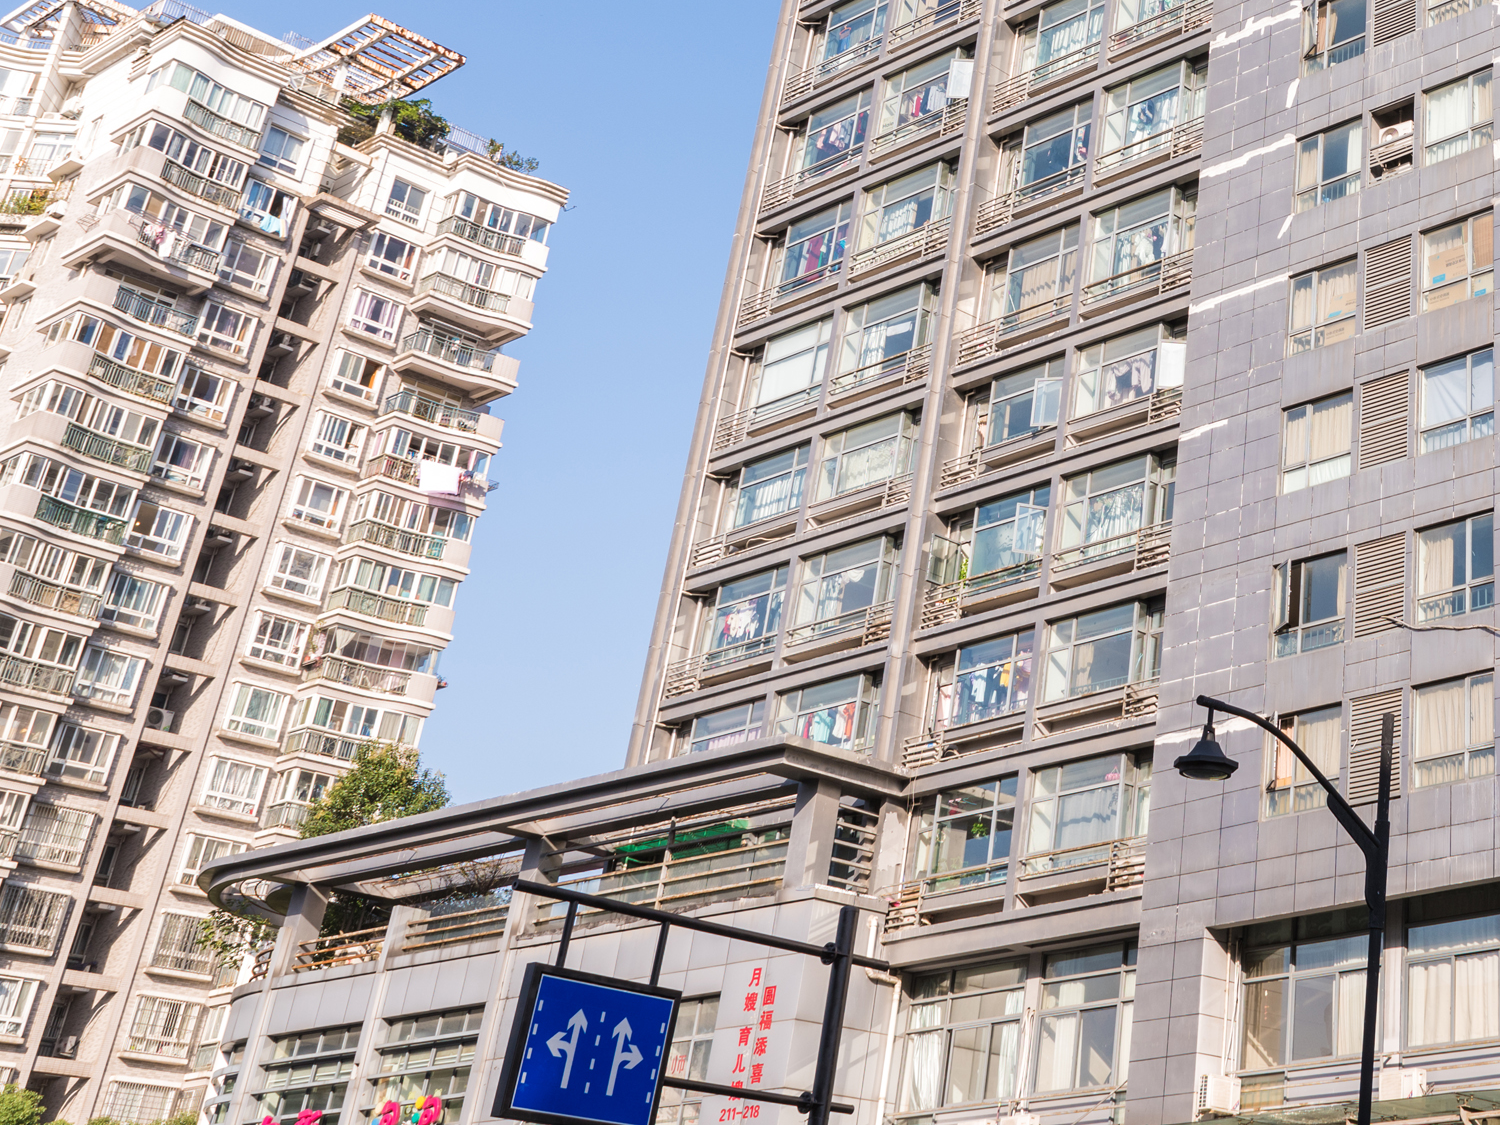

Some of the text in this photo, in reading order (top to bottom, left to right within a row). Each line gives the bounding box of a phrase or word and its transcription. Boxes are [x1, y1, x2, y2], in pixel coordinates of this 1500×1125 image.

[750, 985, 777, 1085] 圆福添喜
[719, 1105, 760, 1122] 211-218
